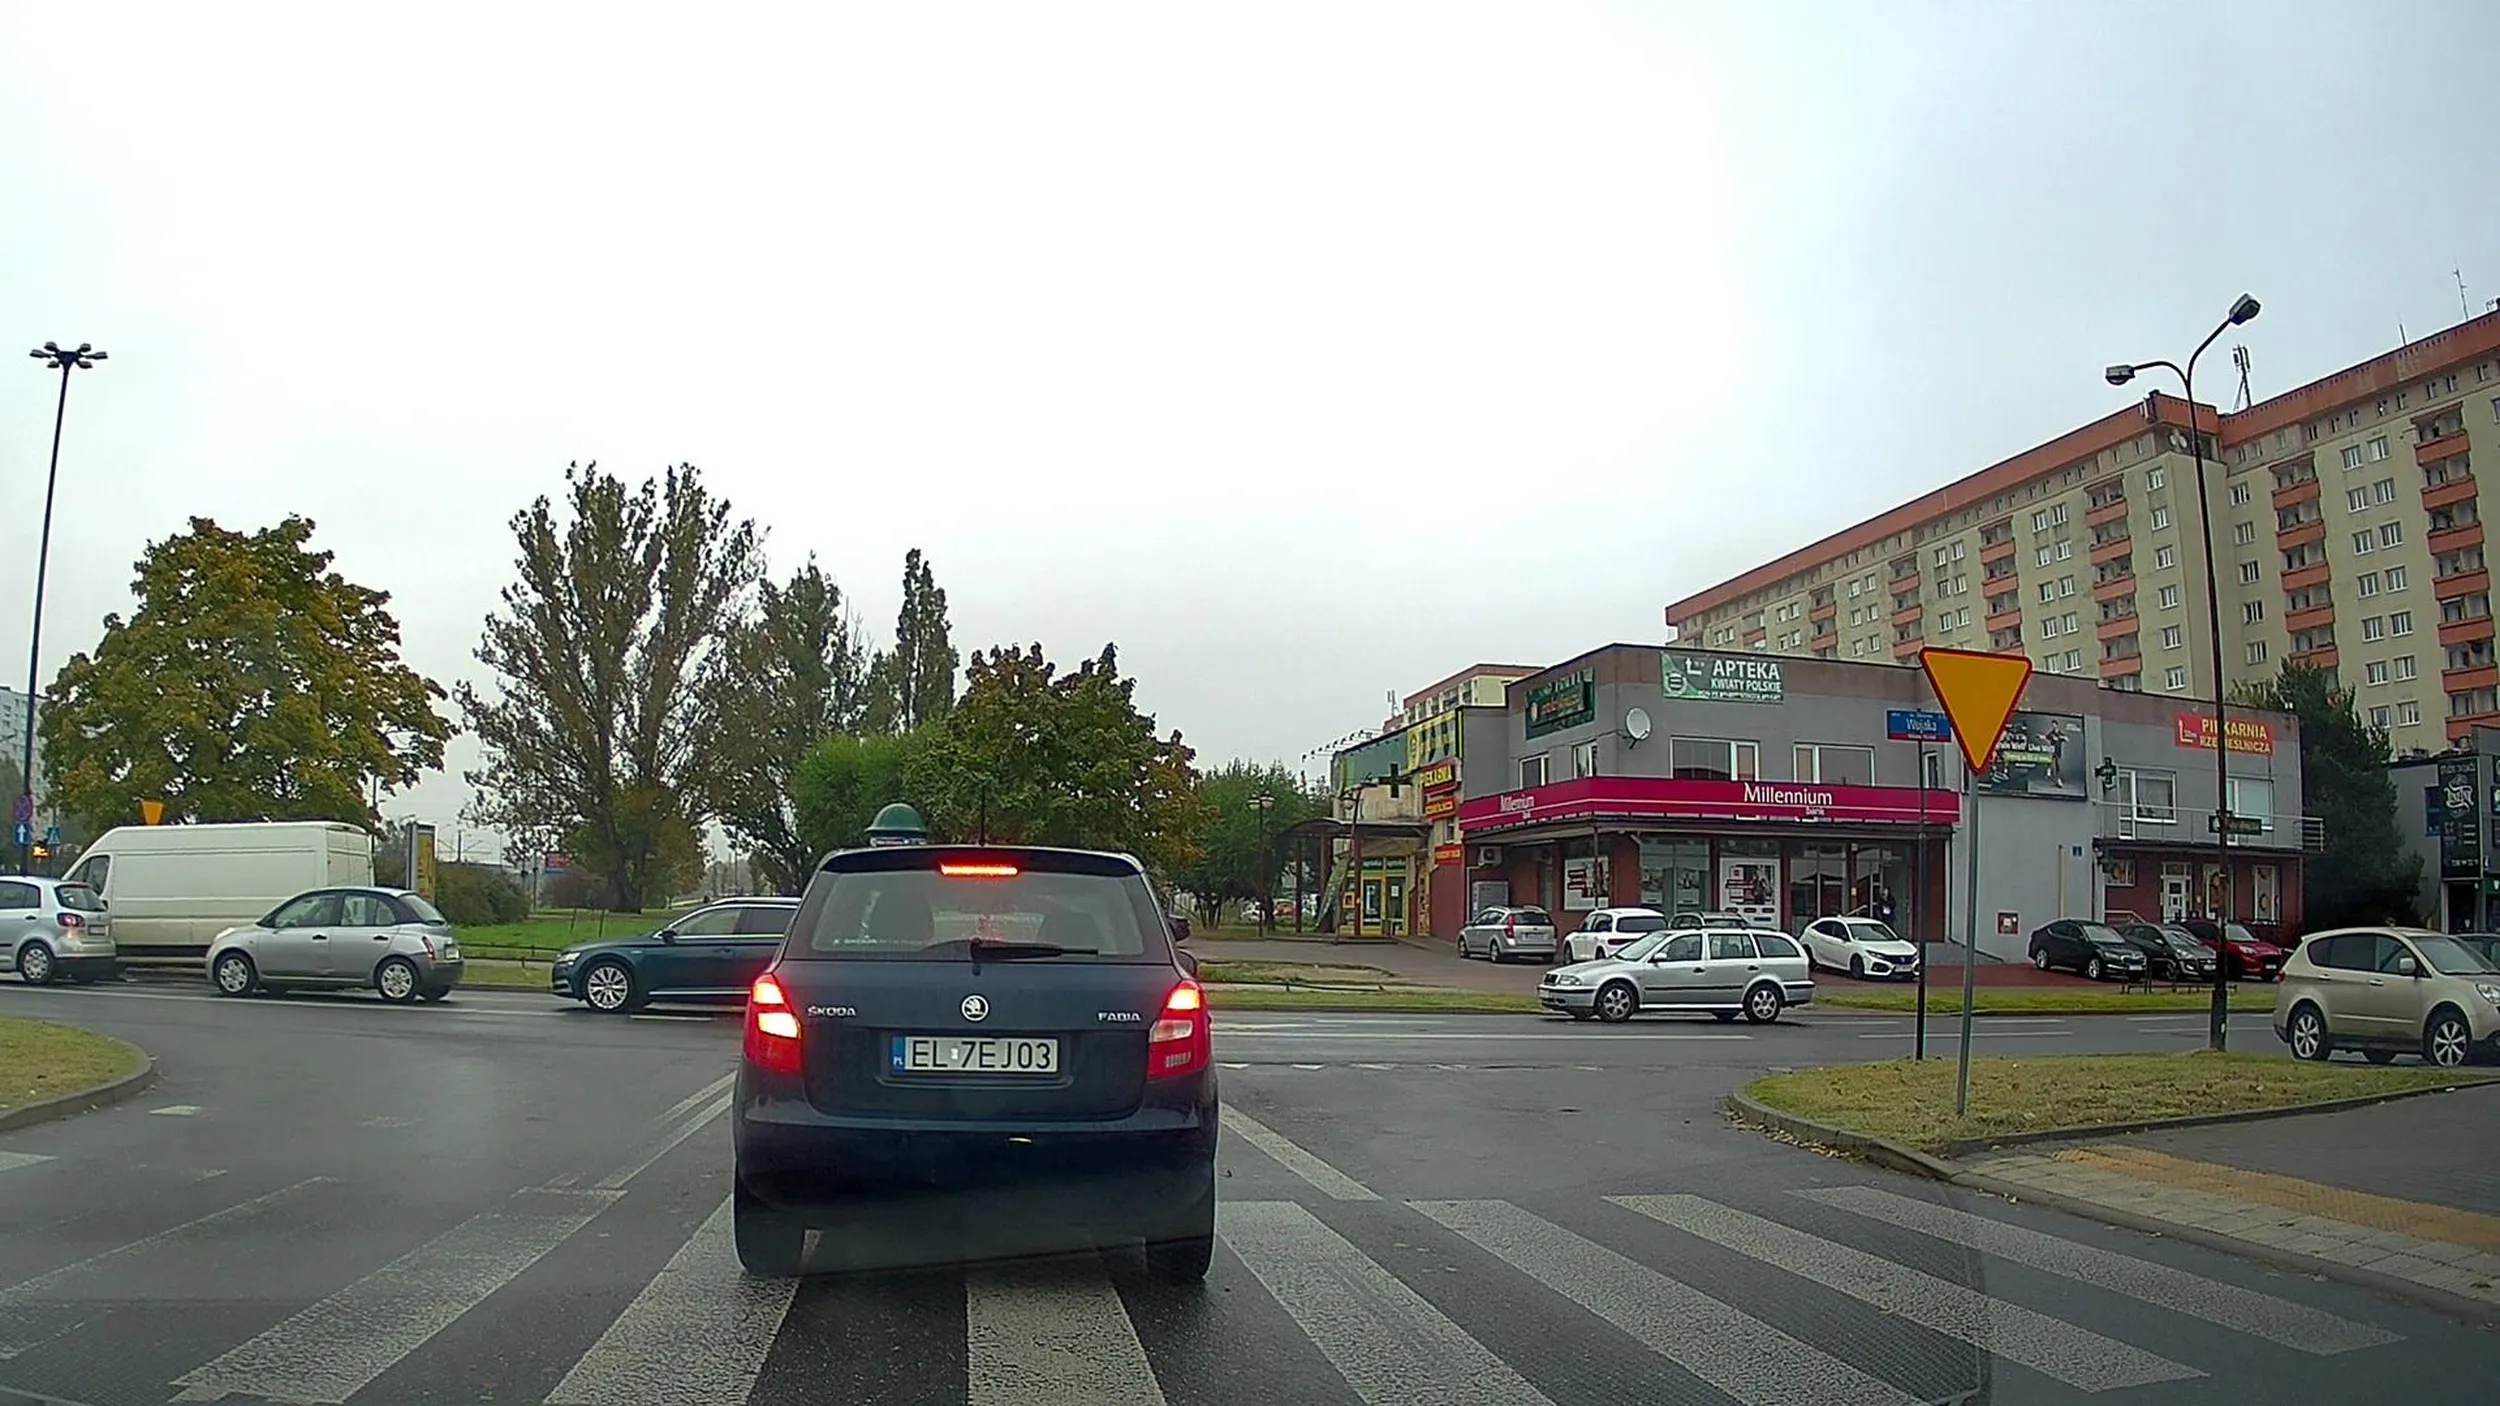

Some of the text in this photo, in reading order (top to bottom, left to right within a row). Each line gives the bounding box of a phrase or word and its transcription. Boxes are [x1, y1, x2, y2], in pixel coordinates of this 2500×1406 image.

[1712, 659, 1781, 680] APTEKA
[1744, 781, 1833, 806] Millennium
[1098, 1012, 1142, 1022] FABIA
[912, 1040, 1050, 1070] EL 7EJ03
